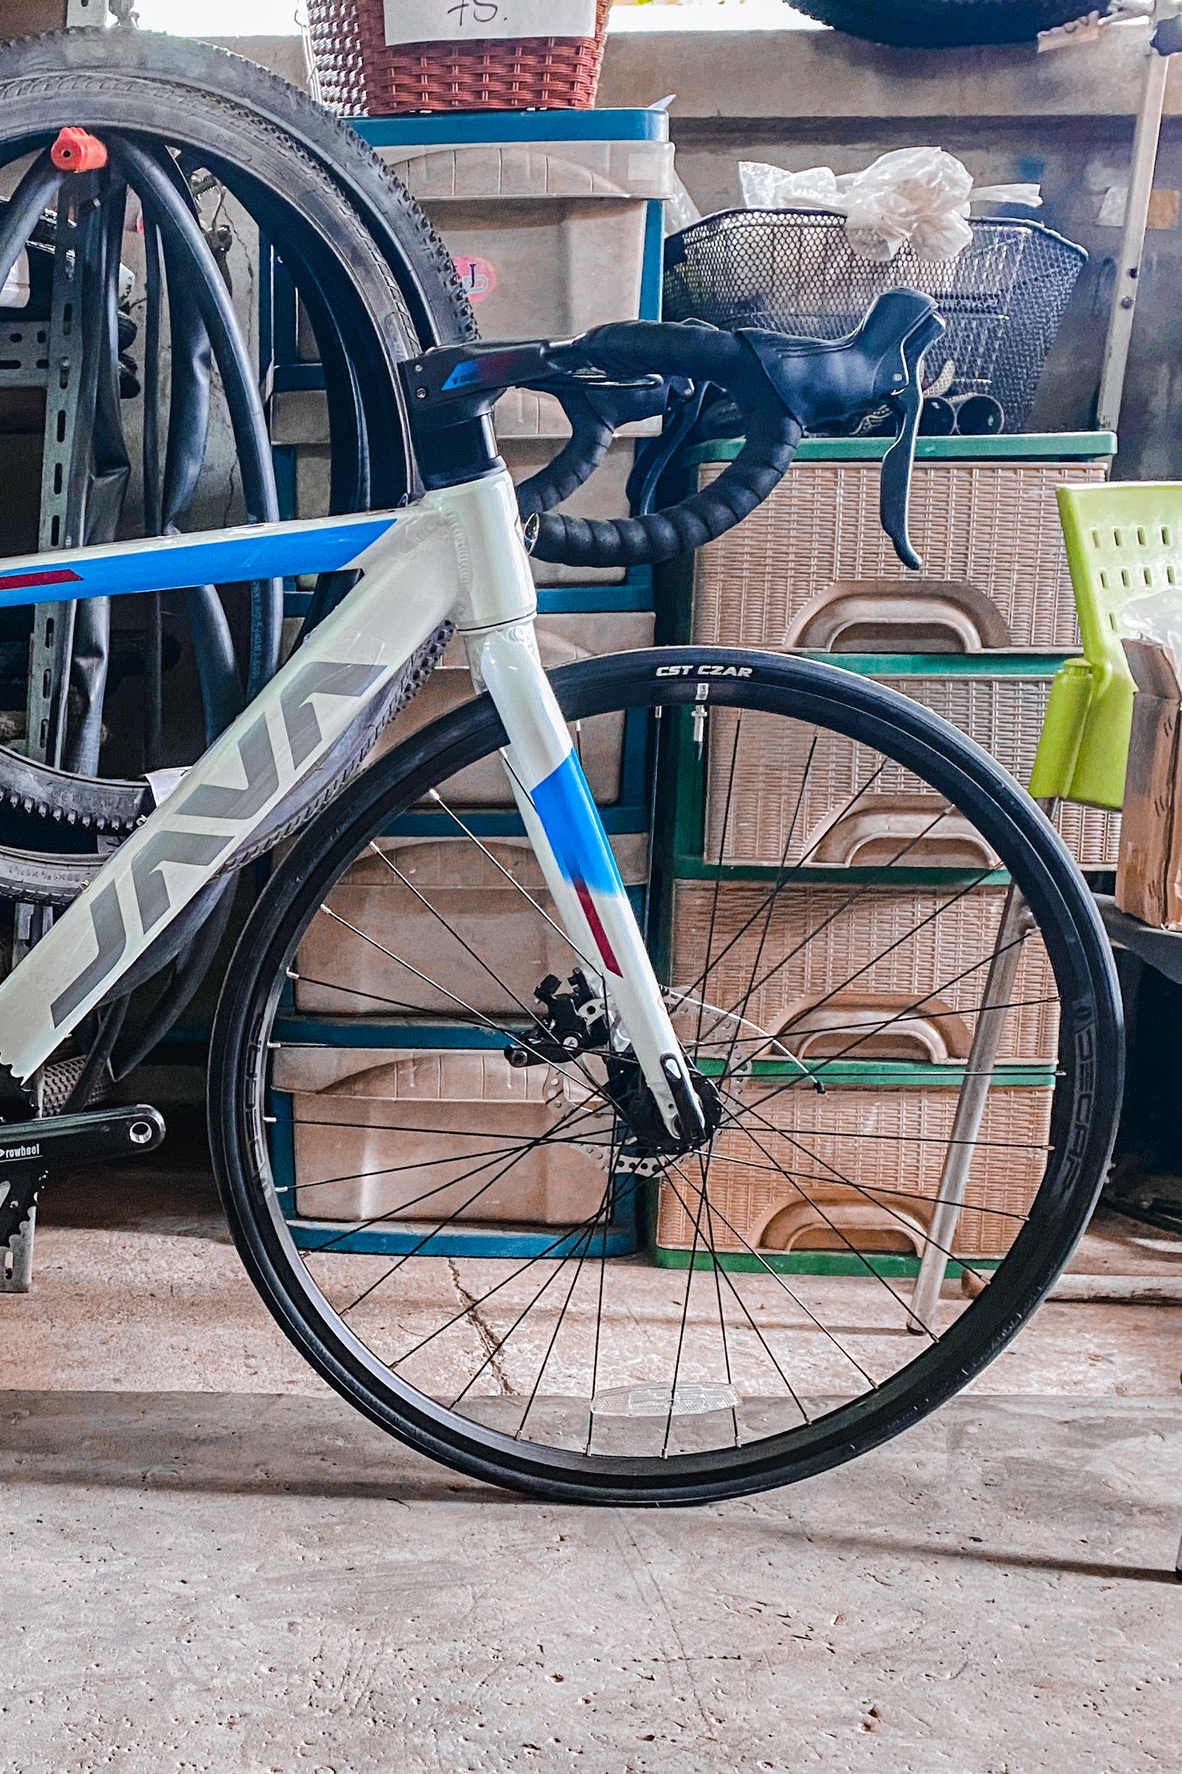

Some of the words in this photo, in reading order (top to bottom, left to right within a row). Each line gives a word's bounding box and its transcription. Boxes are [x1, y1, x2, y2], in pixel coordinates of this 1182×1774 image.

[655, 665, 694, 677] CST
[697, 665, 753, 678] CZAR
[50, 661, 389, 1028] JAVA
